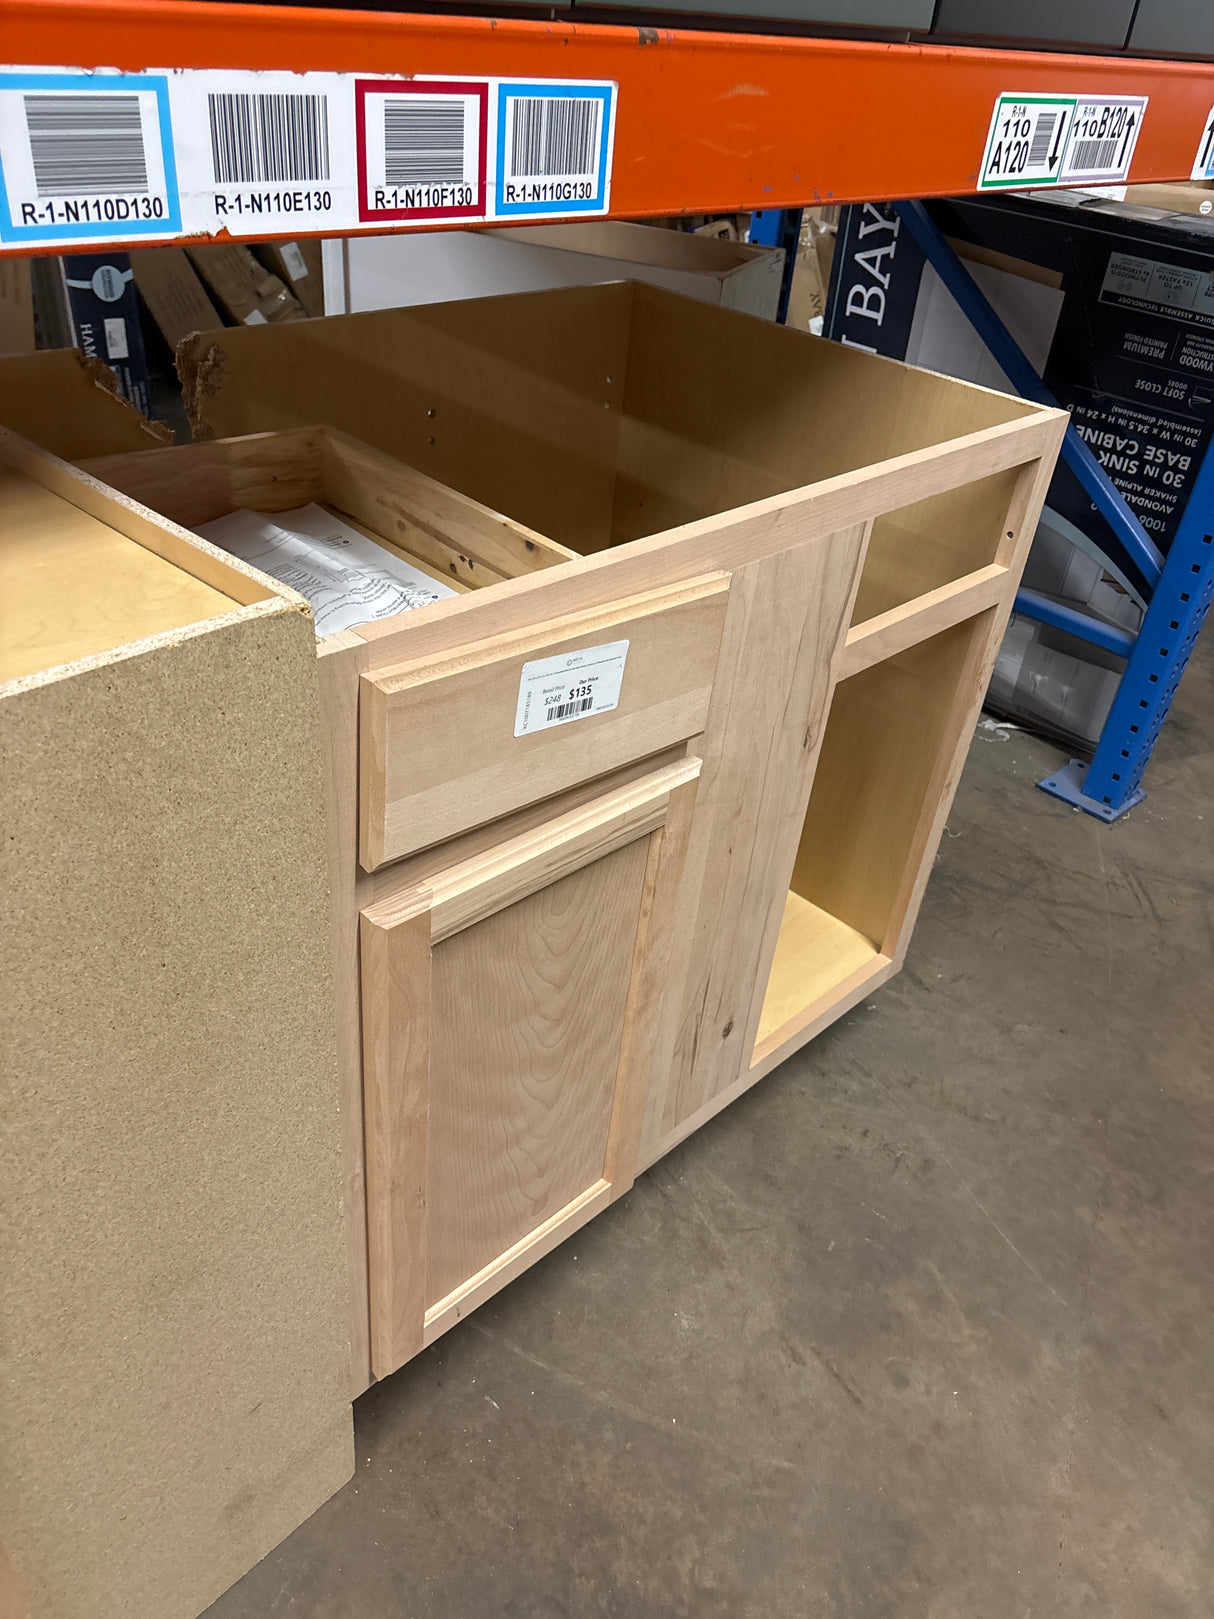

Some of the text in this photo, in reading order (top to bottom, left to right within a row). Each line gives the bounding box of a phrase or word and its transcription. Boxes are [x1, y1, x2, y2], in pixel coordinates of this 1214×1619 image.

[1011, 106, 1028, 118] R-1-N
[1082, 106, 1098, 118] R-1-N
[1002, 119, 1031, 138] 110
[1098, 106, 1127, 139] B120
[988, 140, 1030, 175] A120
[374, 187, 473, 209] R-1-N110F130
[506, 182, 592, 202] R-1-N110G130
[21, 197, 164, 225] R-1-N110D130
[214, 191, 333, 215] R-1-N110E130
[846, 202, 901, 327] BAY
[1118, 297, 1158, 311] TECHNOLOGY
[1123, 340, 1166, 359] PREMIUM
[1134, 379, 1186, 400] SOFT CLOSE
[1168, 380, 1188, 390] DOORS
[1066, 403, 1074, 412] D
[1086, 409, 1099, 419] 24
[1107, 415, 1115, 423] H
[1128, 421, 1150, 434] 34.5
[1160, 431, 1171, 440] W
[1173, 435, 1182, 443] IN
[1184, 438, 1199, 448] 30
[1143, 445, 1192, 471] BASE
[1098, 450, 1186, 488] 30 IN SINK
[1114, 477, 1178, 503] SHAKER ALPINE
[544, 694, 562, 706] $248
[569, 684, 592, 700] $135
